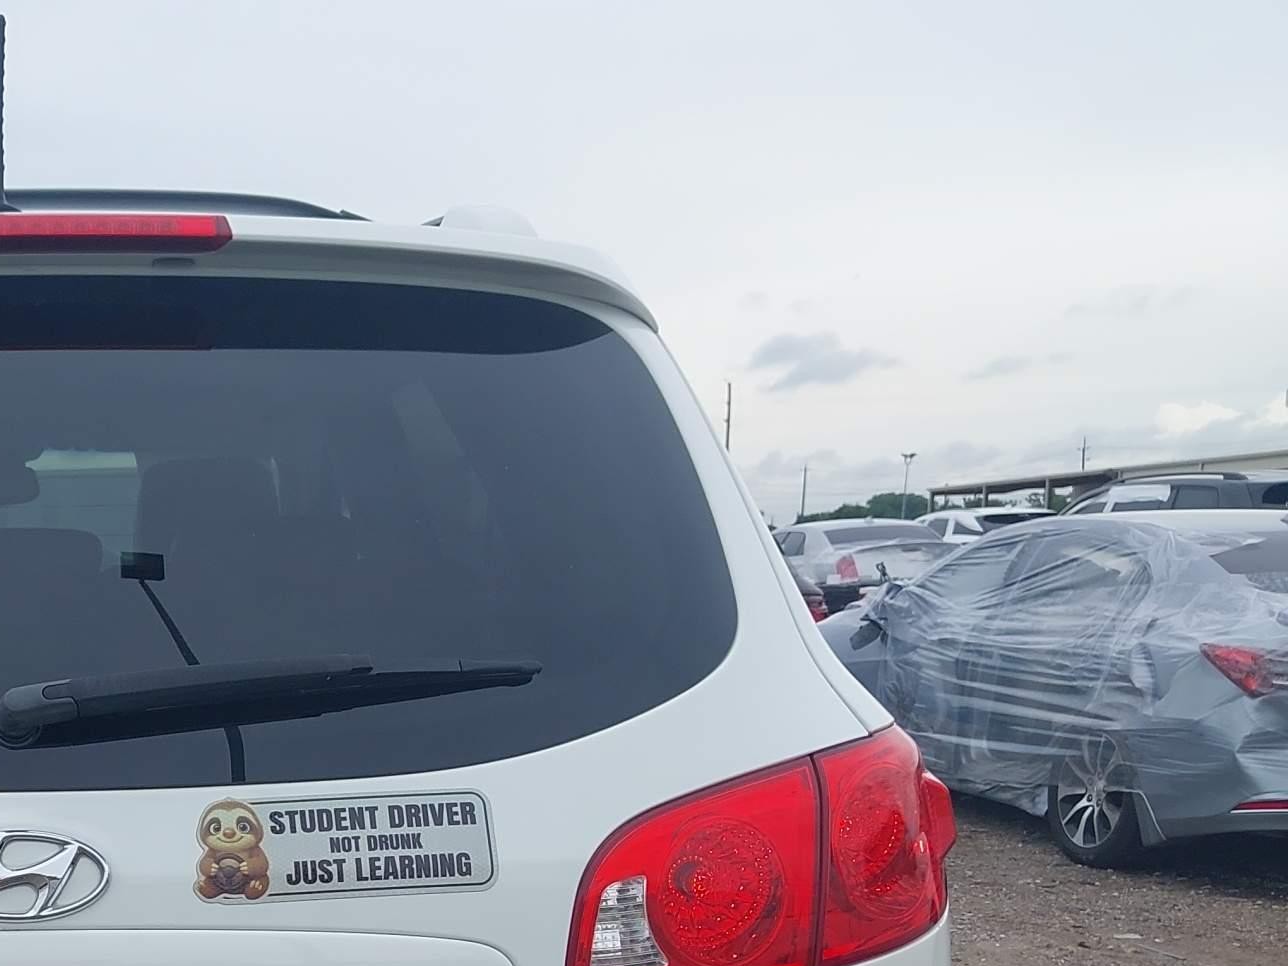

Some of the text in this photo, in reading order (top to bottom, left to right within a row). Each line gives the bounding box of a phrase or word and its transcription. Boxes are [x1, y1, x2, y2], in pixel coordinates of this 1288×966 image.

[269, 801, 477, 835] STUDENT DRIVER
[329, 832, 423, 853] NOT DRUNK
[286, 852, 473, 886] JUST LEARNING
